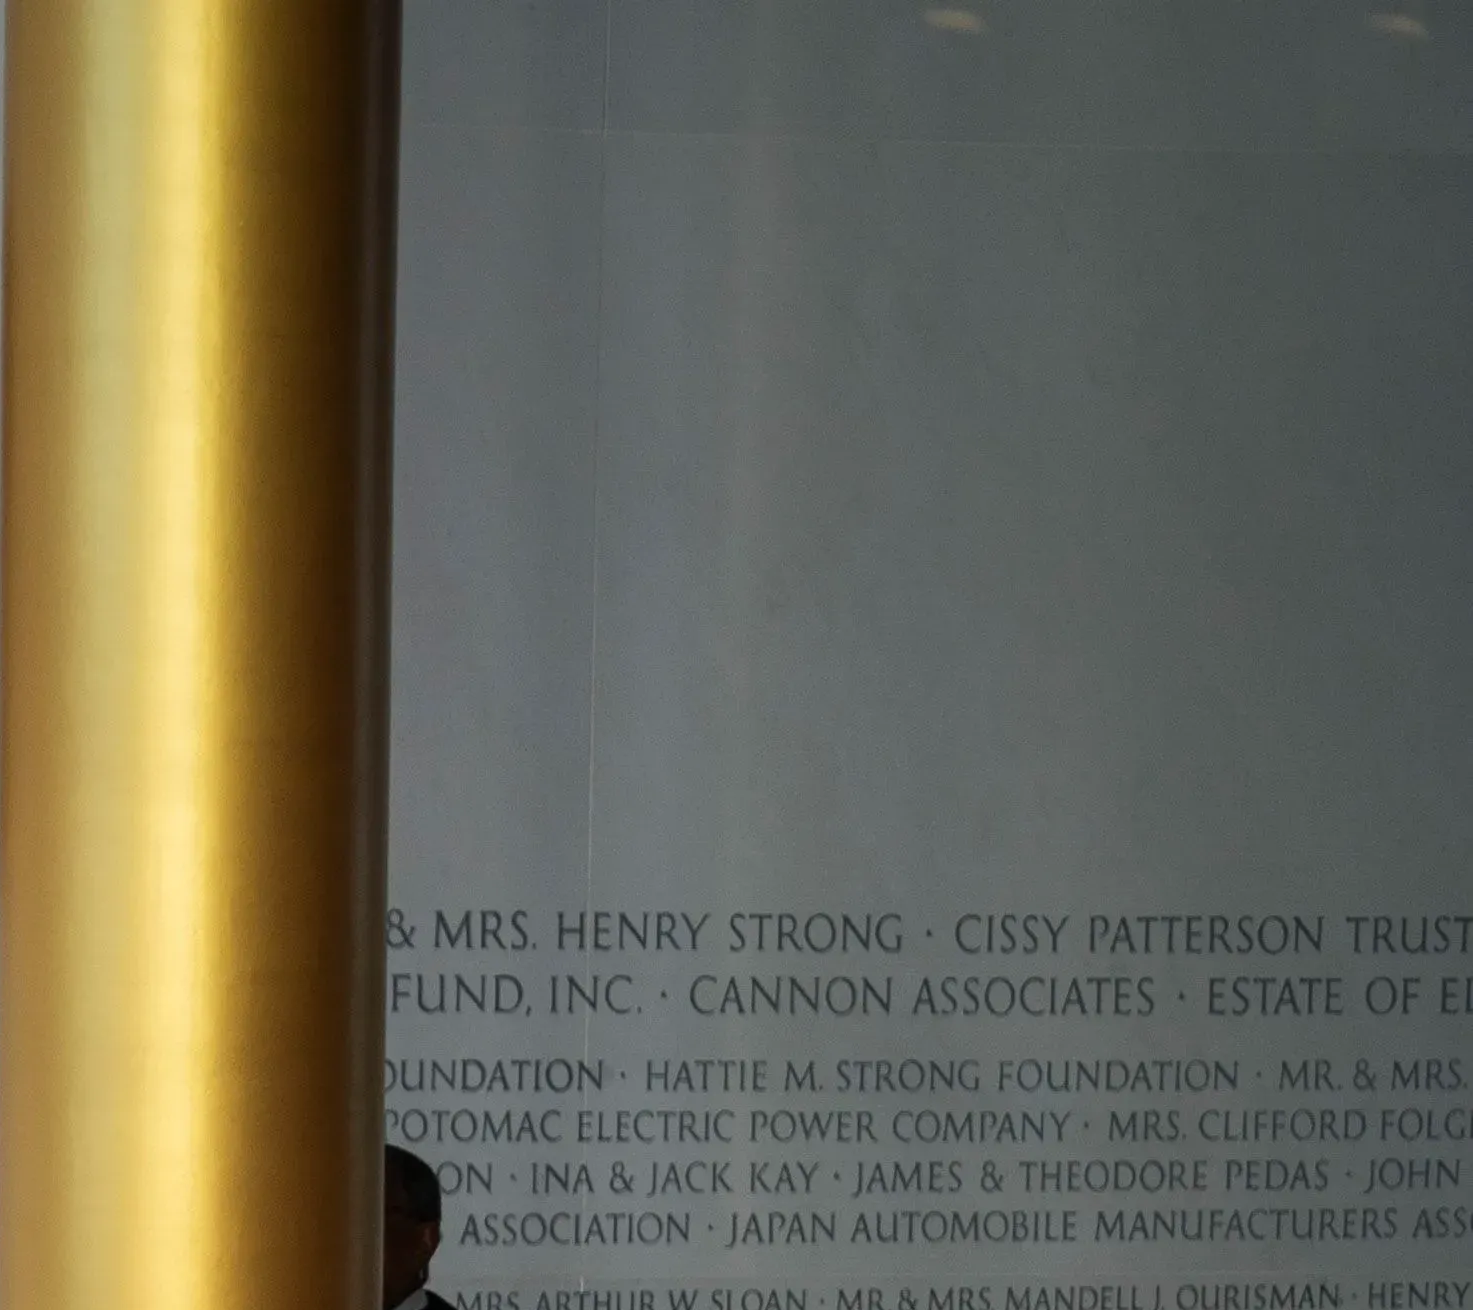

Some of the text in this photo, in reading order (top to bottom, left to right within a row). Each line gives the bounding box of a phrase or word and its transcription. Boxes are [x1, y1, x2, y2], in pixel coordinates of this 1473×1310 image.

[386, 909, 415, 950] &
[434, 911, 537, 950] MRS.
[557, 912, 711, 951] HENRY
[728, 913, 904, 952] STRONG
[955, 914, 1069, 954] CISSY
[1089, 915, 1325, 954] PATTERSON
[1346, 915, 1473, 954] TRUST
[391, 973, 533, 1017] FUND,
[549, 975, 643, 1014] INC.
[690, 975, 892, 1015] CANNON
[912, 977, 1155, 1016] ASSOCIATES
[1208, 976, 1344, 1016] ESTATE
[1365, 976, 1421, 1016] OF
[646, 1059, 767, 1093] HATTIE
[784, 1060, 823, 1092] M.
[838, 1059, 980, 1093] STRONG
[998, 1059, 1240, 1093] FOUNDATION
[1279, 1060, 1343, 1092] MR.
[1353, 1058, 1377, 1091] &
[1390, 1058, 1468, 1091] MRS.
[577, 1110, 735, 1143] ELECTRIC
[750, 1110, 879, 1143] POWER
[893, 1110, 1071, 1144] COMPANY
[1108, 1111, 1186, 1143] MRS.
[1198, 1108, 1368, 1143] CLIFFORD
[1381, 1108, 1473, 1143] FOLG
[532, 1162, 593, 1194] INA
[609, 1161, 634, 1194] &
[647, 1161, 733, 1198] JACK
[750, 1161, 819, 1194] KAY
[854, 1162, 962, 1196] JAMES
[981, 1161, 1004, 1192] &
[1019, 1160, 1207, 1192] THEODORE
[1225, 1159, 1329, 1191] PEDAS
[1363, 1158, 1460, 1193] JOHN
[459, 1212, 691, 1246] ASSOCIATION
[726, 1212, 837, 1247] JAPAN
[851, 1210, 1076, 1243] AUTOMOBILE
[1094, 1208, 1398, 1241] MANUFACTURERS
[1411, 1208, 1473, 1241] ASS
[1367, 1282, 1471, 1310] HENRY
